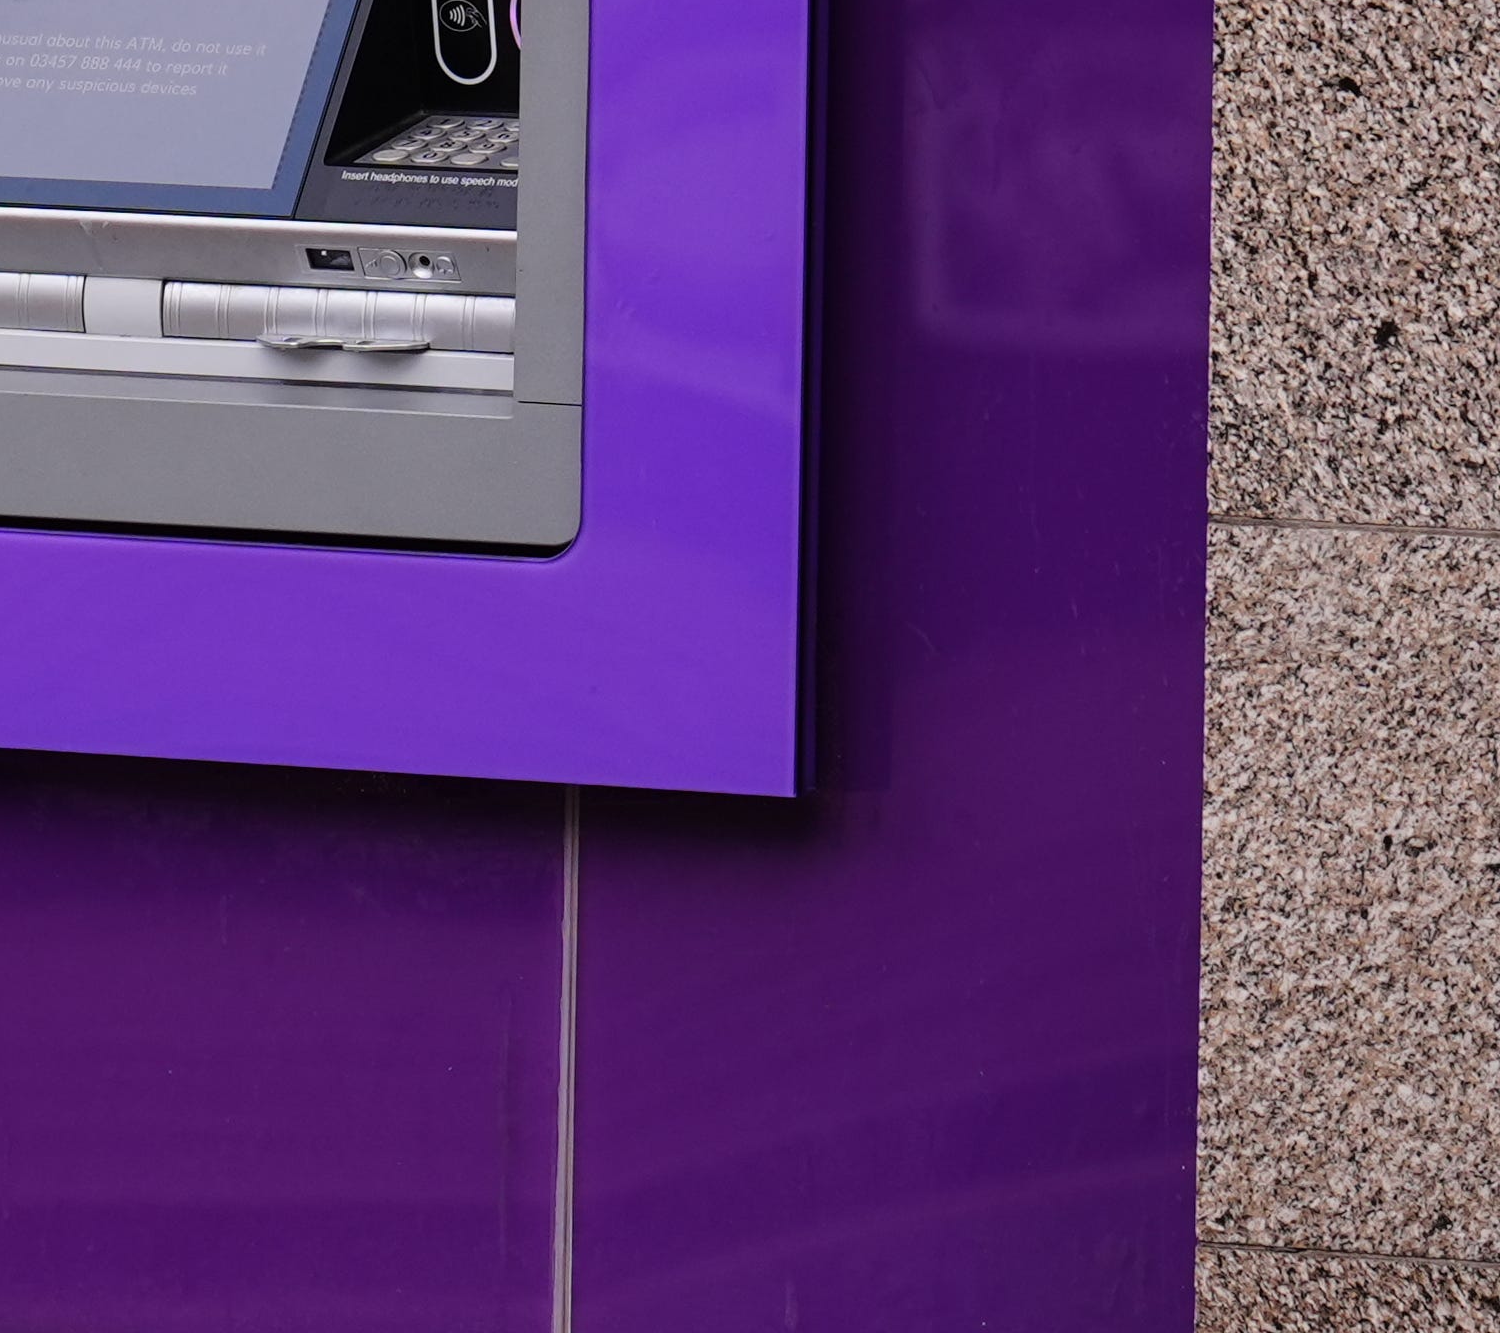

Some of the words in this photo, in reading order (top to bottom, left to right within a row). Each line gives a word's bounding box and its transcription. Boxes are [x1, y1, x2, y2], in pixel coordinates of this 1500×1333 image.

[46, 34, 91, 49] about
[95, 35, 122, 50] this
[171, 38, 191, 53] do
[195, 40, 222, 54] not
[225, 43, 252, 56] use
[256, 42, 267, 56] it
[5, 56, 25, 67] on
[30, 53, 77, 69] 03457
[113, 57, 142, 72] 444
[146, 60, 162, 73] to
[165, 61, 214, 77] report
[217, 61, 229, 76] it
[25, 77, 54, 93] any
[59, 78, 136, 94] suspicious
[140, 80, 198, 96] devices
[341, 170, 370, 182] Insert
[370, 172, 428, 185] headphones
[429, 174, 440, 184] to
[441, 176, 459, 185] use
[460, 176, 495, 188] speech
[496, 177, 518, 188] mod
